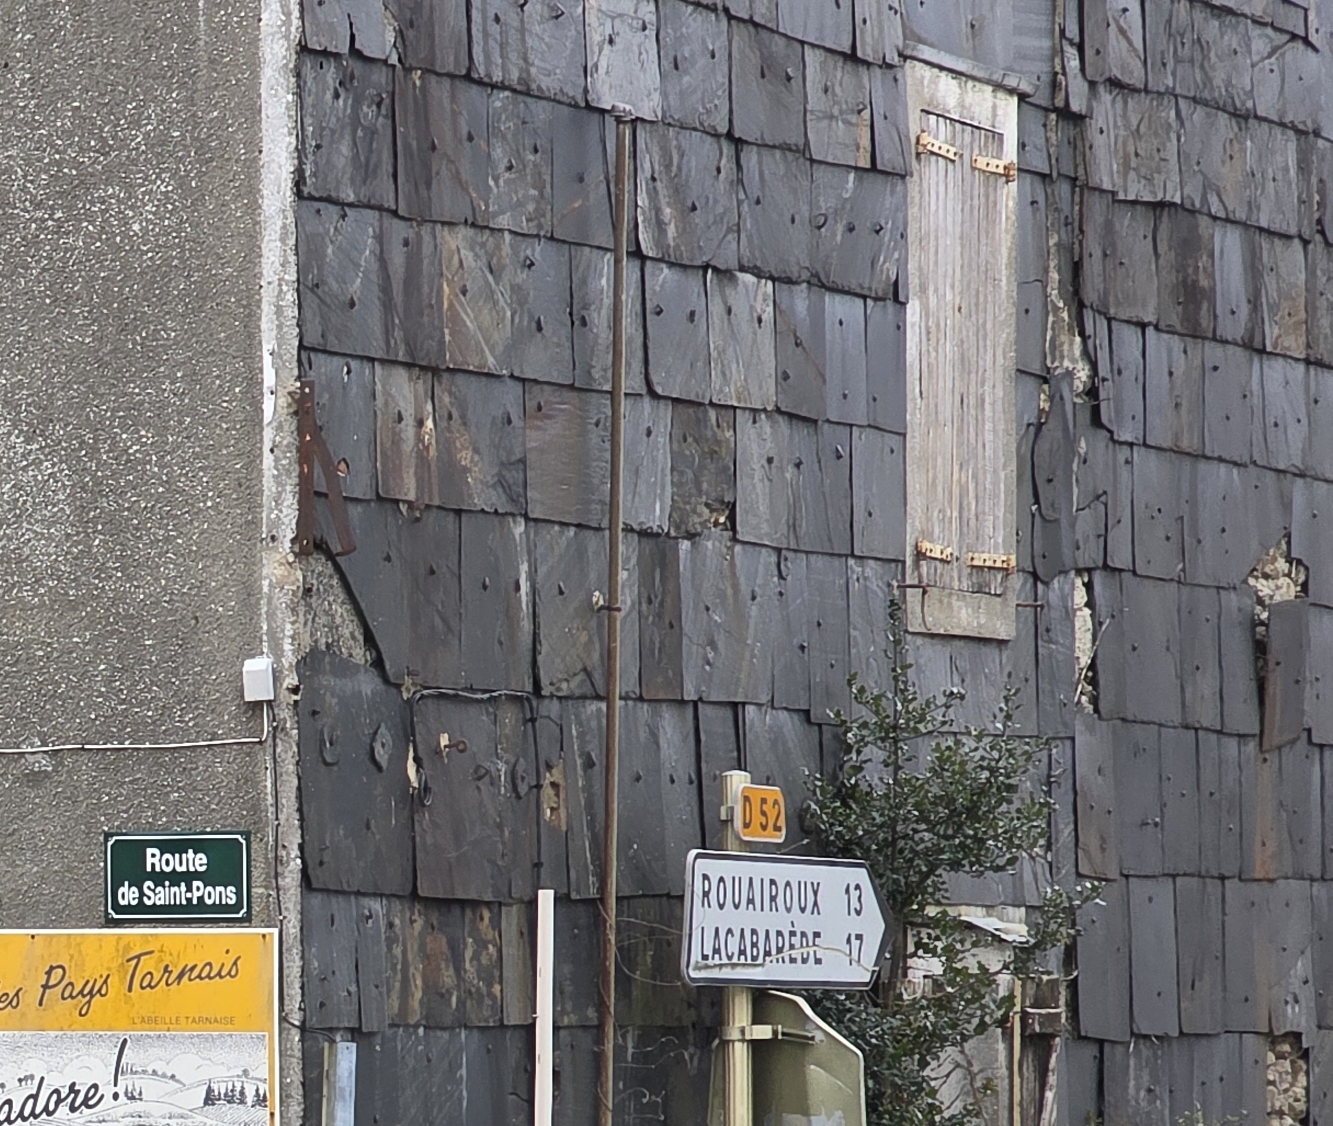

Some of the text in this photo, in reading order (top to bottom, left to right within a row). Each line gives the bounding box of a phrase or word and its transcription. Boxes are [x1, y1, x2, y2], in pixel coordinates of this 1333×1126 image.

[742, 795, 782, 832] D 52
[145, 847, 208, 872] Route
[117, 880, 237, 905] de Saint-Pons
[701, 873, 863, 916] ROUAIROUX 13
[700, 921, 864, 966] LACABARÈDE 17
[38, 964, 111, 1018] Pays
[126, 948, 241, 993] Tarnais
[132, 1016, 236, 1025] L'ABEILLE TARNAISE
